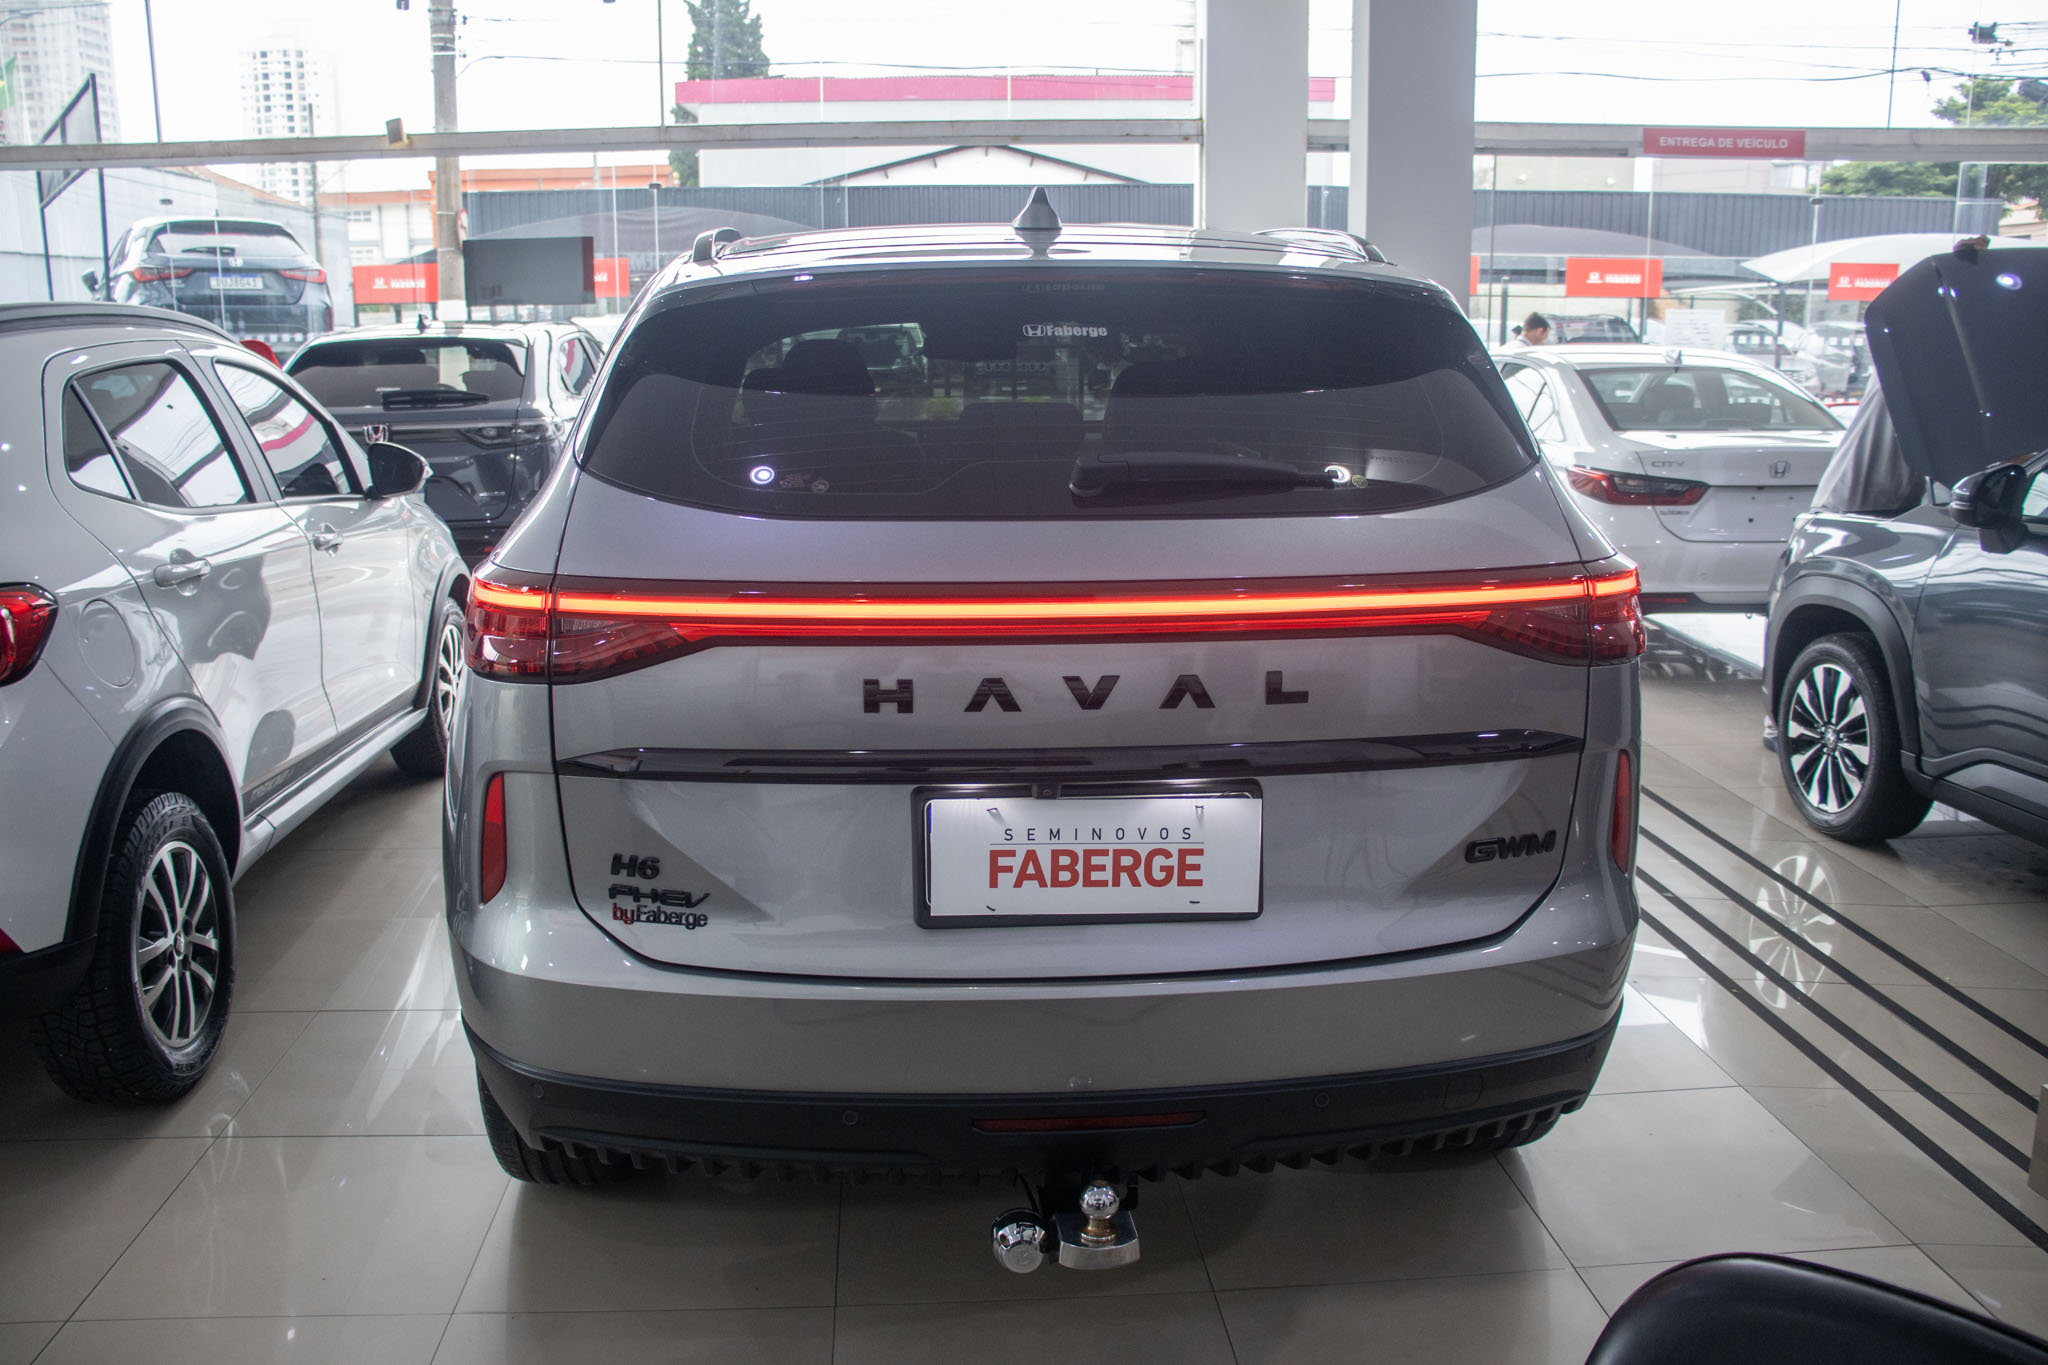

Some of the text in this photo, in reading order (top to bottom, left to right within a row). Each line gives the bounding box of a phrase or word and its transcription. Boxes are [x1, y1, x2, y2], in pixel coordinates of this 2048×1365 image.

[1659, 136, 1788, 149] ENTREGA DE VEÍCULO
[1046, 325, 1108, 337] Faberge
[863, 671, 1309, 714] HAVAL
[1004, 827, 1191, 841] SEMINOVOS
[1465, 829, 1557, 863] GWM
[610, 853, 660, 880] H6
[989, 848, 1204, 888] FABERGE
[608, 884, 710, 908] PHEV
